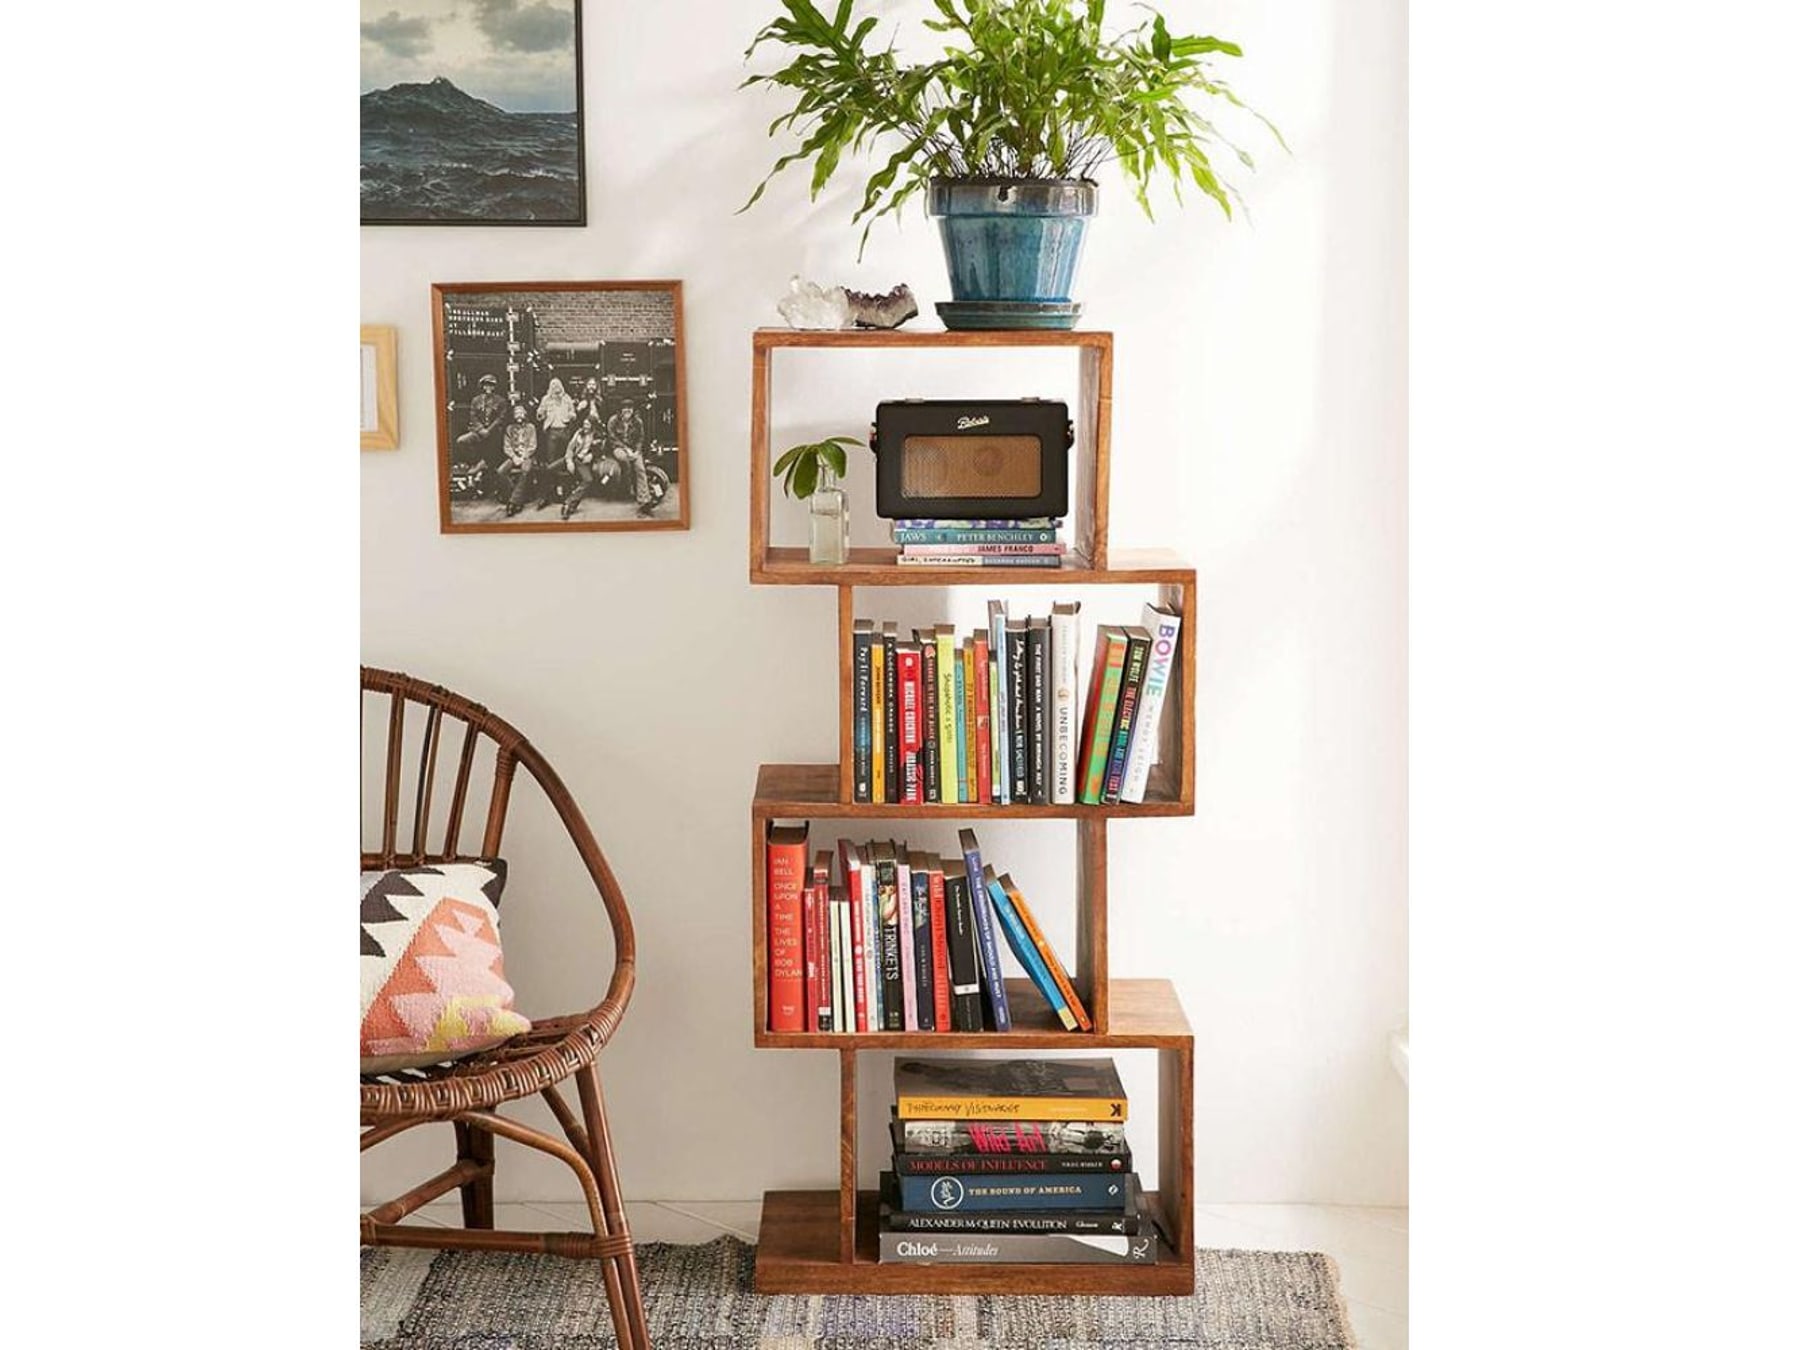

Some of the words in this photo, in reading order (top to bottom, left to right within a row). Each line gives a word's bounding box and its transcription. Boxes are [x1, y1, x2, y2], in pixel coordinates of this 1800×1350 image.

[900, 530, 927, 542] JAWS
[957, 530, 985, 542] PETER
[986, 530, 1034, 542] BENCHLEY
[977, 544, 1002, 553] JAMES
[1004, 544, 1034, 553] FRANCO
[858, 647, 869, 662] Pay
[1146, 624, 1176, 697] BOWIE
[860, 664, 869, 673] It
[859, 674, 869, 712] Forward
[1058, 707, 1069, 796] UNBECOMING
[974, 876, 982, 889] THE
[774, 913, 793, 921] TIME
[774, 927, 791, 935] THE
[884, 927, 899, 981] TRINKETS
[774, 969, 802, 977] DYLAN
[910, 1160, 959, 1171] MODELS
[960, 1160, 976, 1171] OF
[980, 1160, 1046, 1171] INFLUENCE
[968, 1188, 988, 1196] THE
[990, 1187, 1021, 1195] SOUND
[1023, 1187, 1036, 1195] OF
[1038, 1186, 1082, 1194] AMERICA
[908, 1218, 967, 1229] ALEXANDER
[1012, 1218, 1067, 1229] EVOLUTION
[897, 1241, 938, 1257] Chloé
[952, 1243, 999, 1257] Attitudes
